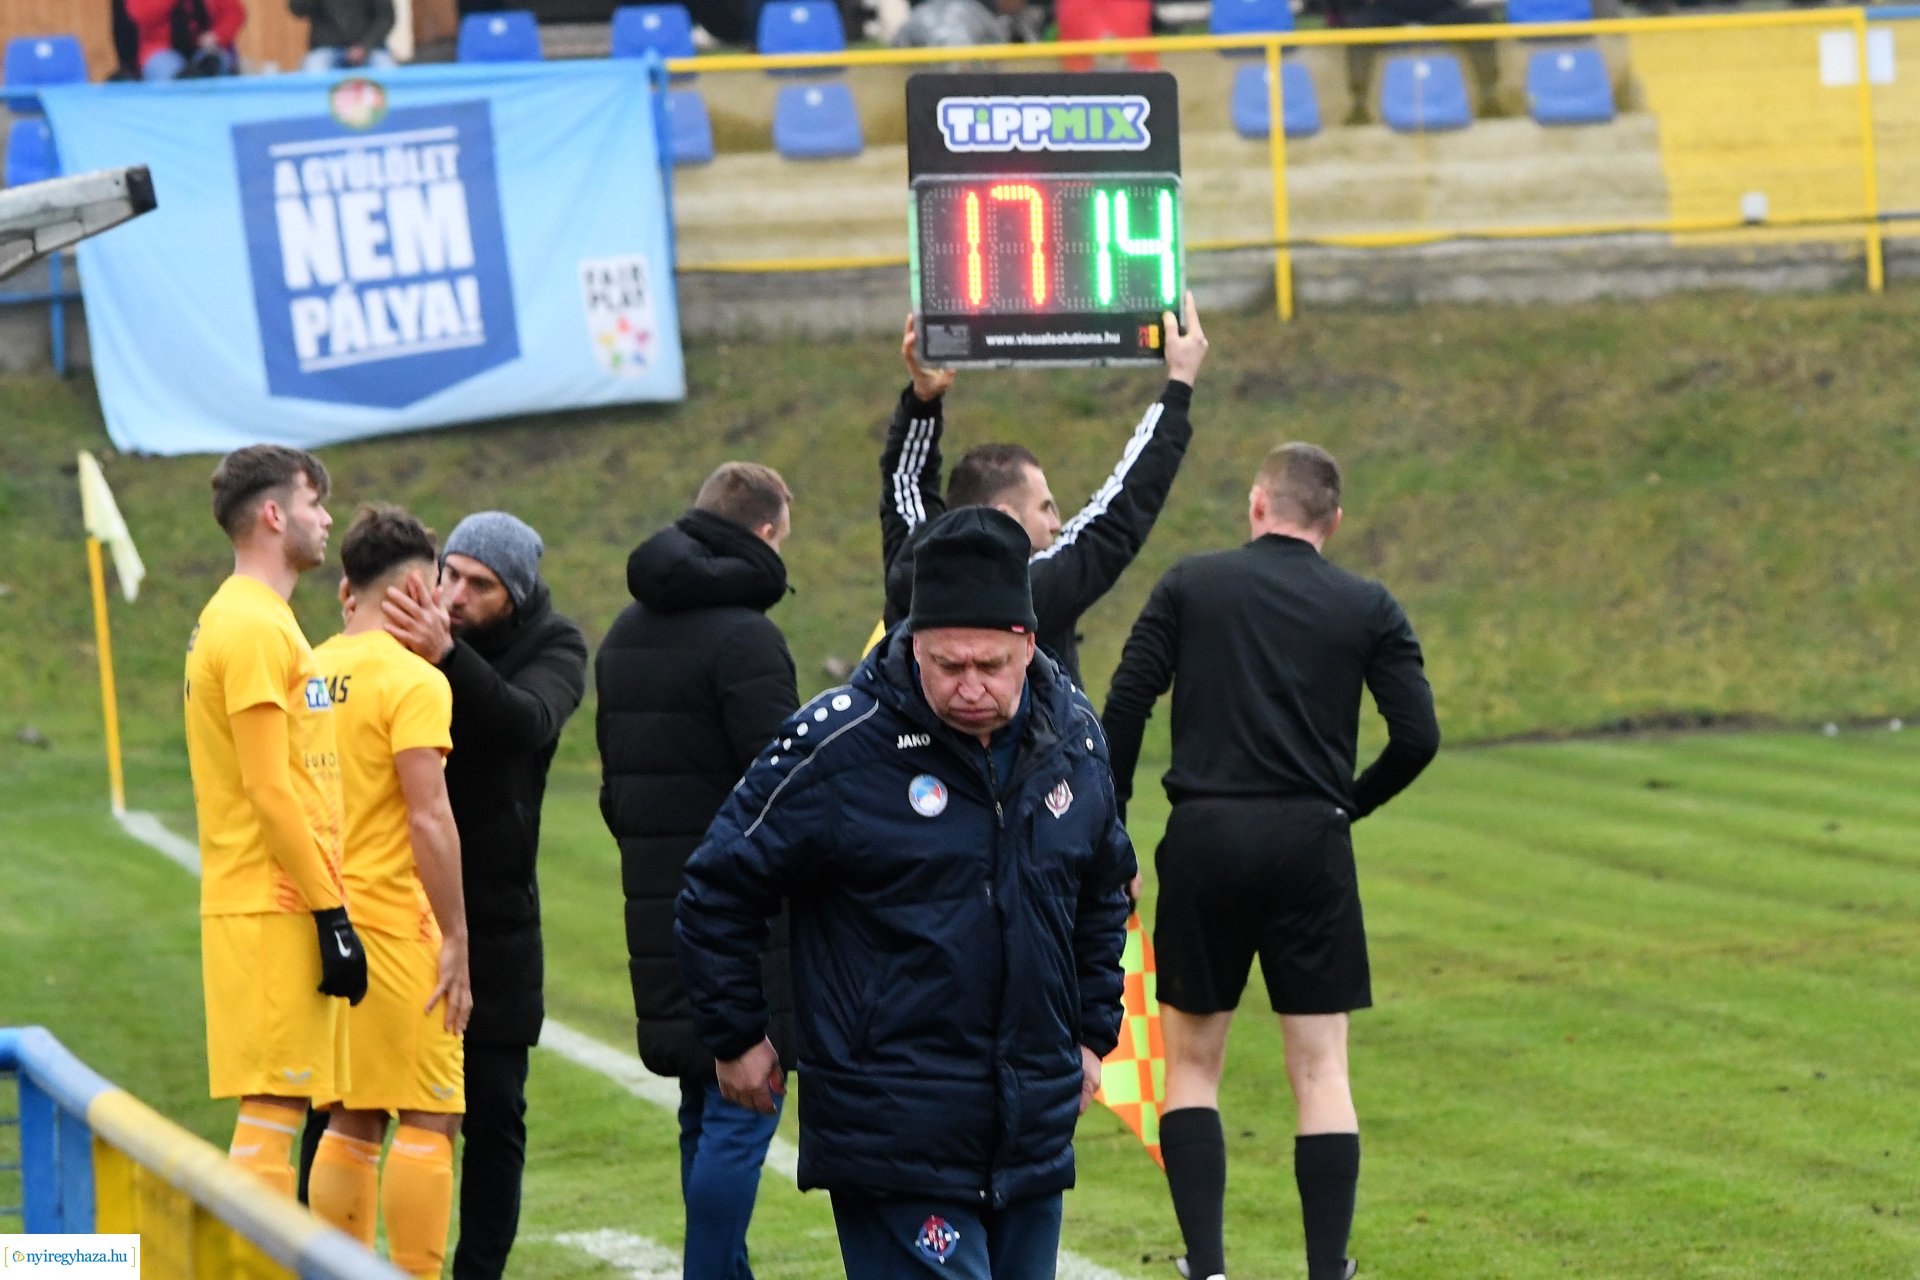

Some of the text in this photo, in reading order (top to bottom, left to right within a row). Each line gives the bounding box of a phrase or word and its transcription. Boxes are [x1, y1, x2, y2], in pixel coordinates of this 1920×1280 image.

[275, 160, 301, 196] A
[275, 179, 475, 290] NEM
[963, 184, 1176, 307] 17 14
[585, 263, 645, 287] FAIR
[290, 274, 481, 359] PÁLYA!
[985, 330, 1121, 346] www.visualsolutions.hu
[896, 733, 931, 750] JAKO
